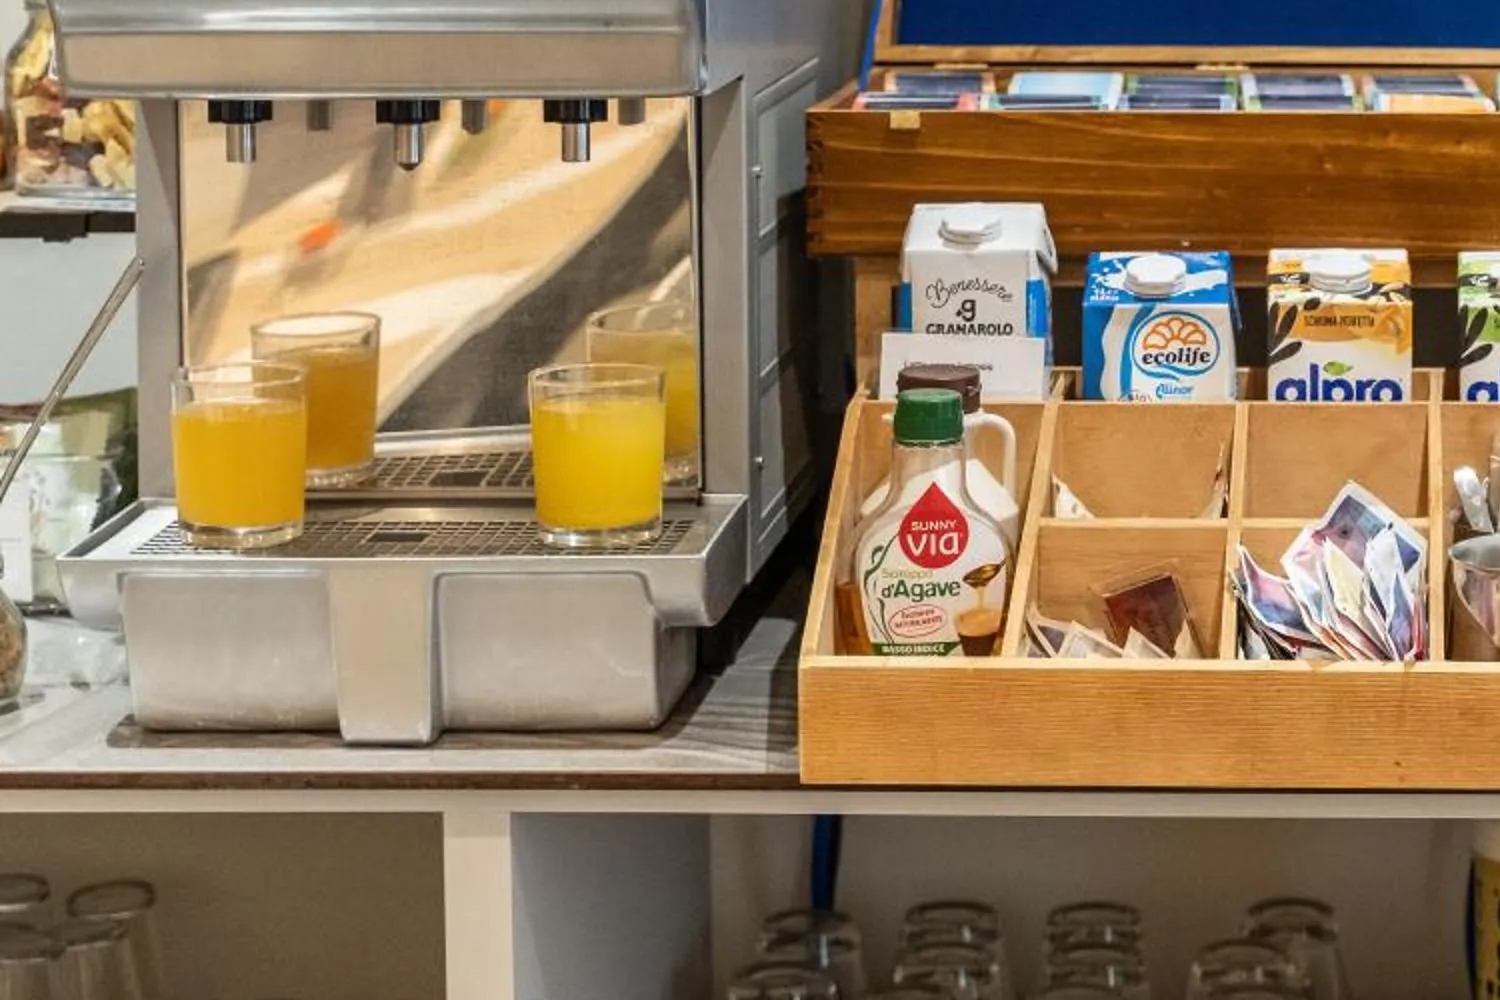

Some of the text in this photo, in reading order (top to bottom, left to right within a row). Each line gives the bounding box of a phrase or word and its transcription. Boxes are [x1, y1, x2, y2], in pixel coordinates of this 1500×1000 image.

[925, 322, 1014, 337] GRANAROLO
[1141, 347, 1211, 367] ecolife
[1274, 362, 1403, 403] alpro
[911, 519, 958, 532] SUNNY
[880, 579, 962, 603] d'Agave
